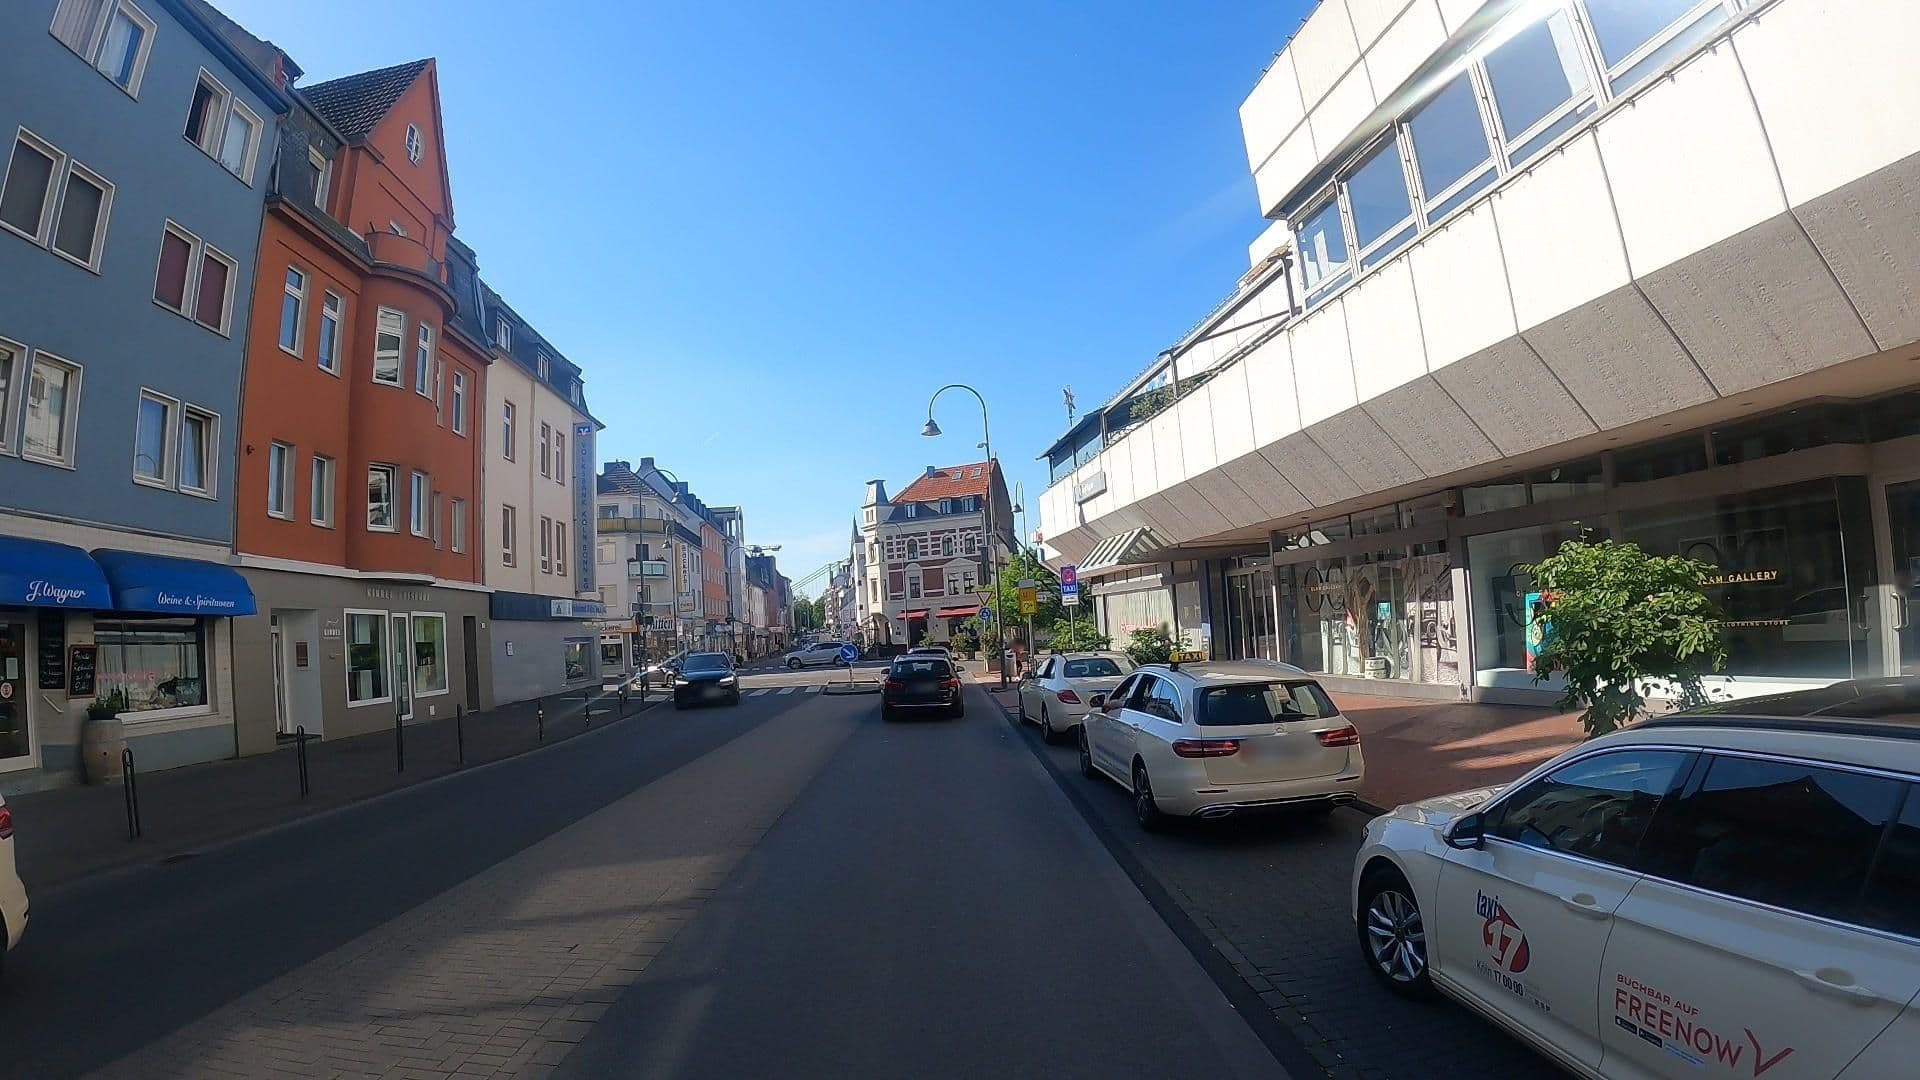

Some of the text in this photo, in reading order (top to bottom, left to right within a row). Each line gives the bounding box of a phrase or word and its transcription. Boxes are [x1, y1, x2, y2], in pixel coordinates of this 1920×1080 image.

[1728, 570, 1778, 582] GALLERY
[158, 591, 182, 605] Weine
[184, 596, 192, 606] &
[1062, 585, 1076, 593] TAXI
[1179, 652, 1204, 661] TAXI
[1476, 889, 1501, 921] taxi
[1487, 919, 1523, 969] 17
[1494, 969, 1502, 982] 17
[1502, 974, 1513, 991] 00
[1513, 982, 1524, 997] 00
[1616, 974, 1700, 1017] BUCHBAR AUF
